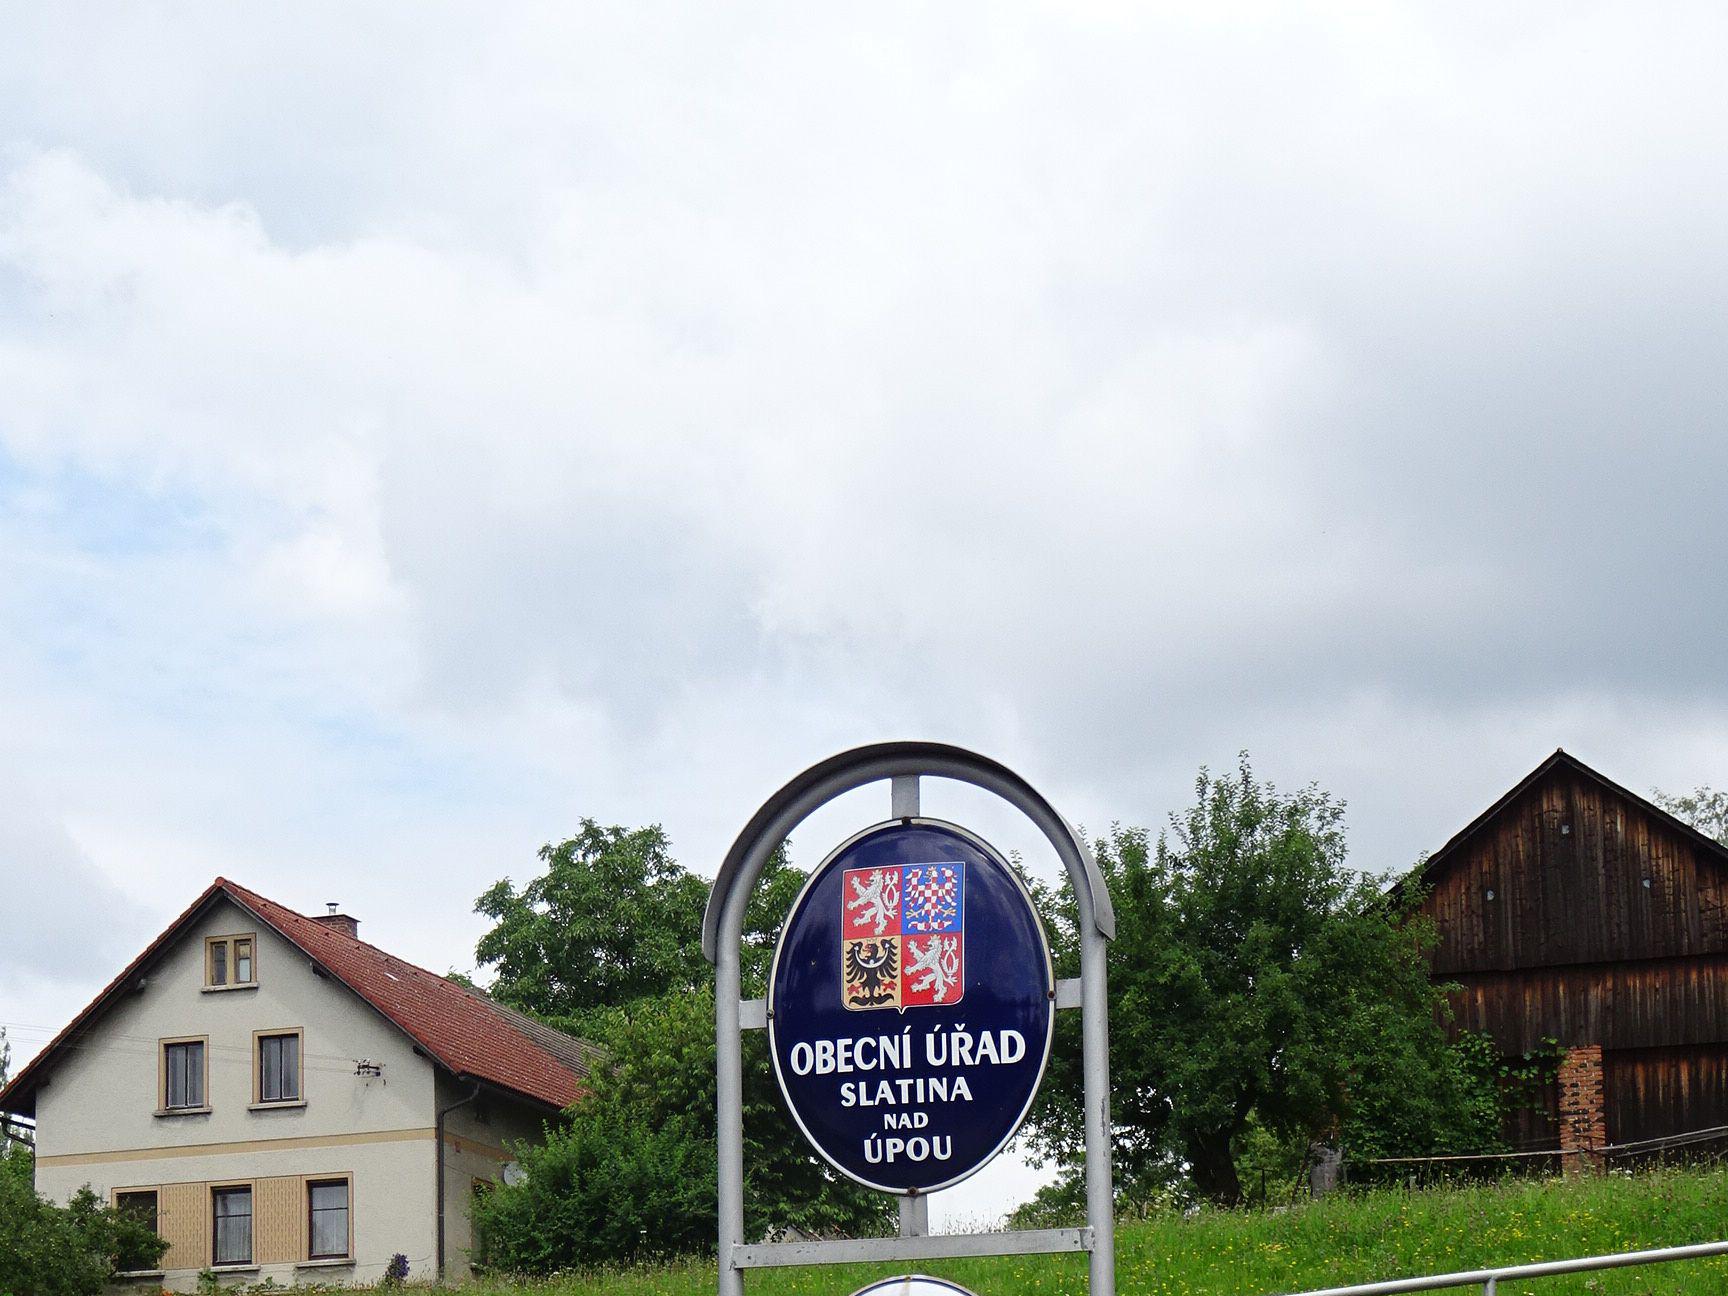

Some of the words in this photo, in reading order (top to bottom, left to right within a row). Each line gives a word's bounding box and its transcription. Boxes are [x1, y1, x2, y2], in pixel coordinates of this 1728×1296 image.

[790, 1025, 911, 1076] OBECNÍ
[926, 1023, 1026, 1067] ÚŘAD
[840, 1076, 973, 1107] SLATINA
[883, 1112, 929, 1130] NAD
[864, 1133, 952, 1164] ÚPOU
